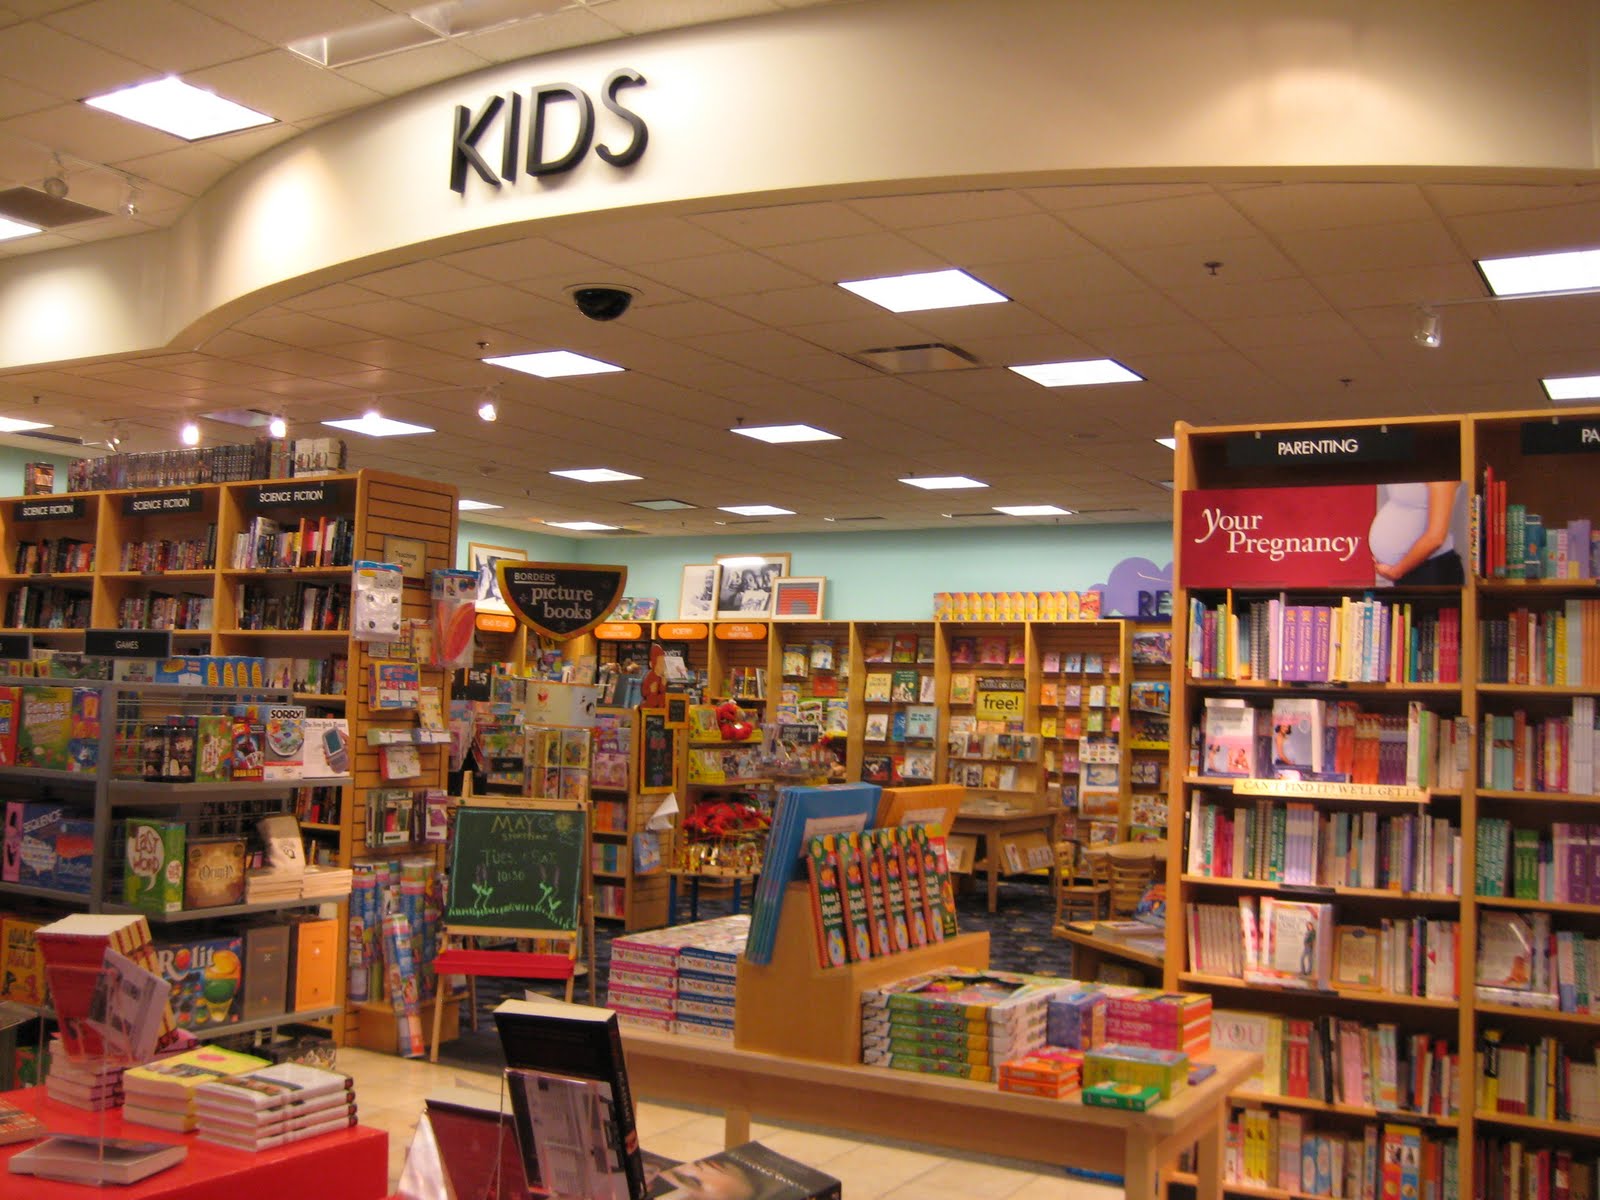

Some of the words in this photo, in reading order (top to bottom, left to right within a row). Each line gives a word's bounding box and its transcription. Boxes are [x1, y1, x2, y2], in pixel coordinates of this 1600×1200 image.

[450, 67, 649, 193] KIDS
[1581, 427, 1600, 443] PA
[1278, 438, 1359, 456] PARENTING
[133, 499, 162, 511] SCIENCE
[163, 497, 190, 509] FICTION
[259, 491, 292, 503] SCIENCE
[294, 490, 323, 501] FICTION
[23, 506, 48, 516] SCIENCE
[49, 504, 74, 515] FICTION
[1194, 508, 1263, 543] your
[1227, 530, 1359, 562] Pregnancy
[514, 572, 556, 583] BORDERS
[531, 586, 594, 605] picture
[543, 601, 593, 620] books
[115, 640, 139, 650] GAMES
[983, 694, 1019, 710] free!
[491, 815, 536, 834] MAY
